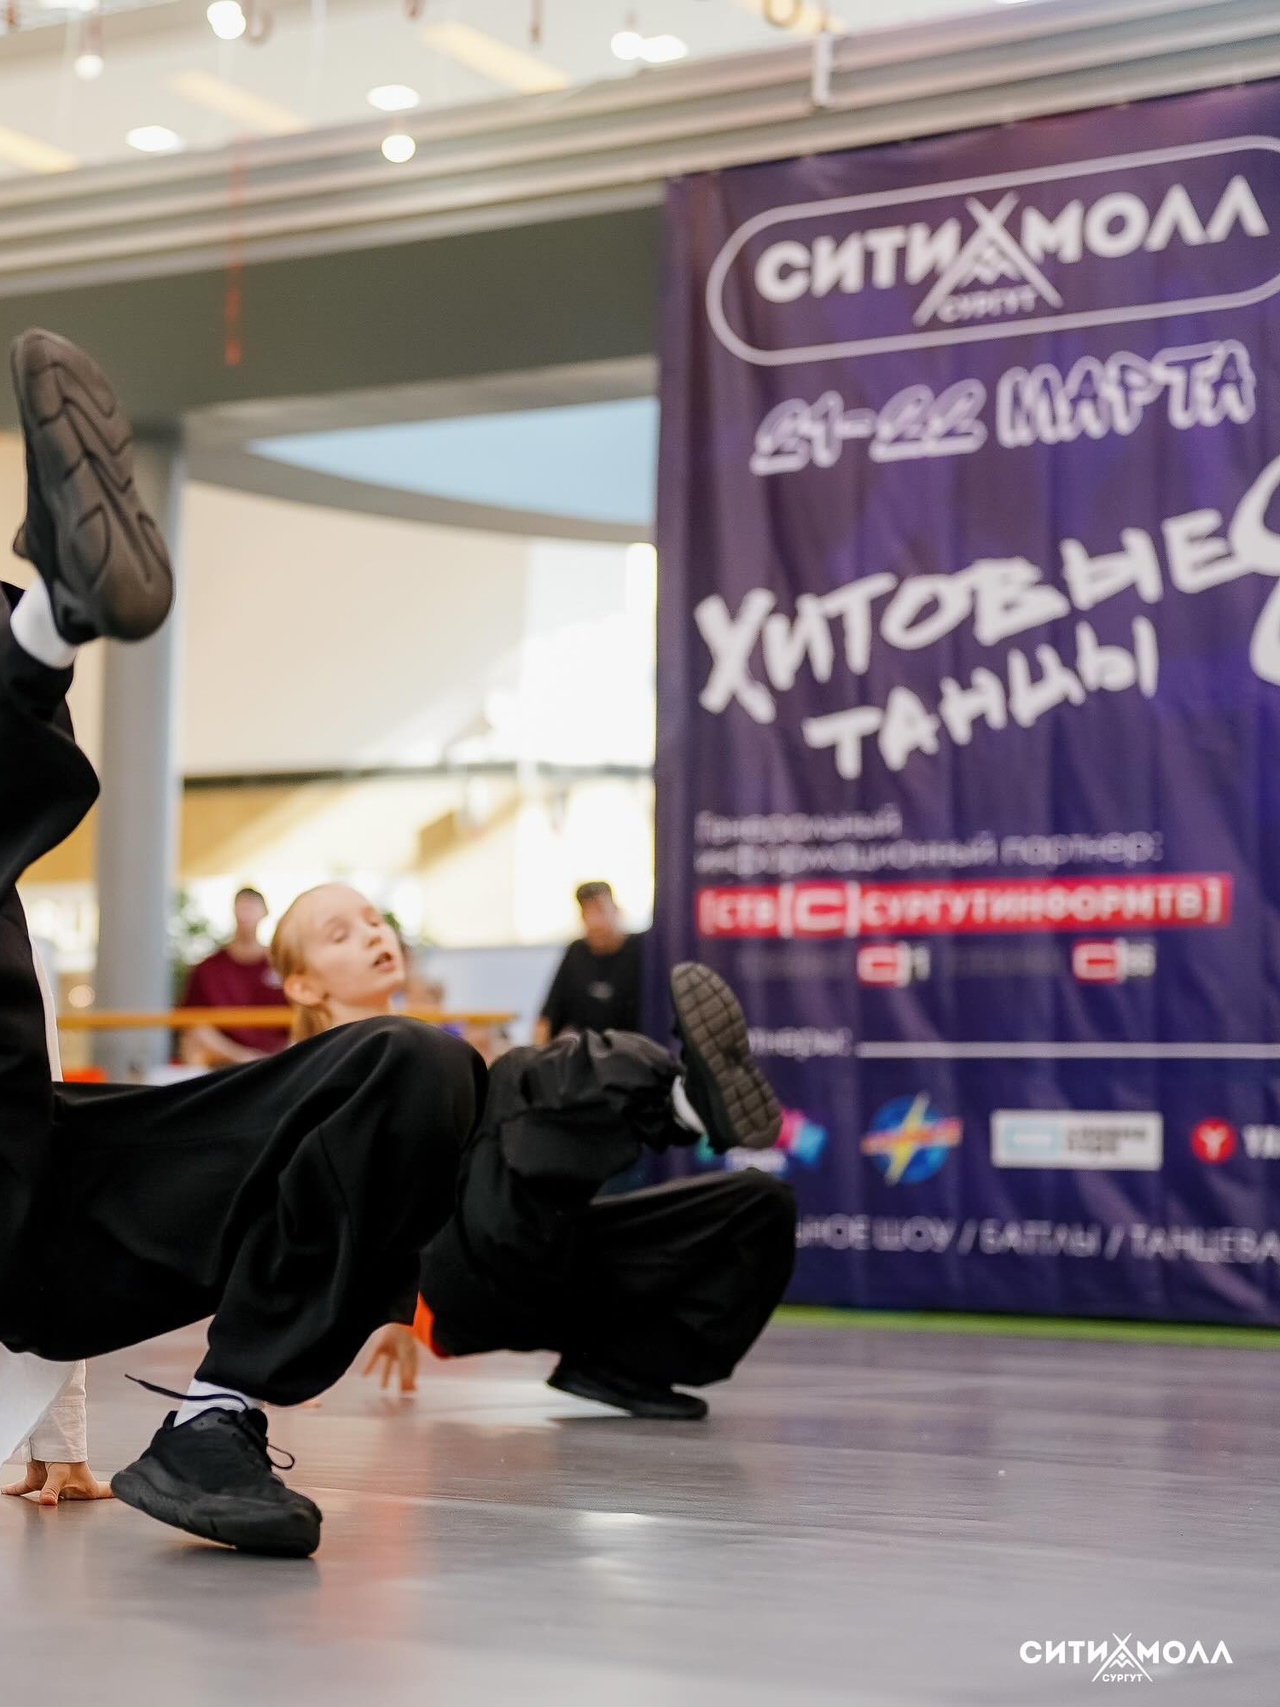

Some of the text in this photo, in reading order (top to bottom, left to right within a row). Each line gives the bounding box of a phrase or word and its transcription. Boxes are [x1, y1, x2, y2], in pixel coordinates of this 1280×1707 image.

[1021, 174, 1269, 266] МОЛЛ
[996, 339, 1257, 449] МАРТА
[694, 508, 1238, 724] ХИТОВЫЕ
[803, 616, 1159, 780] ТАНЦЫ
